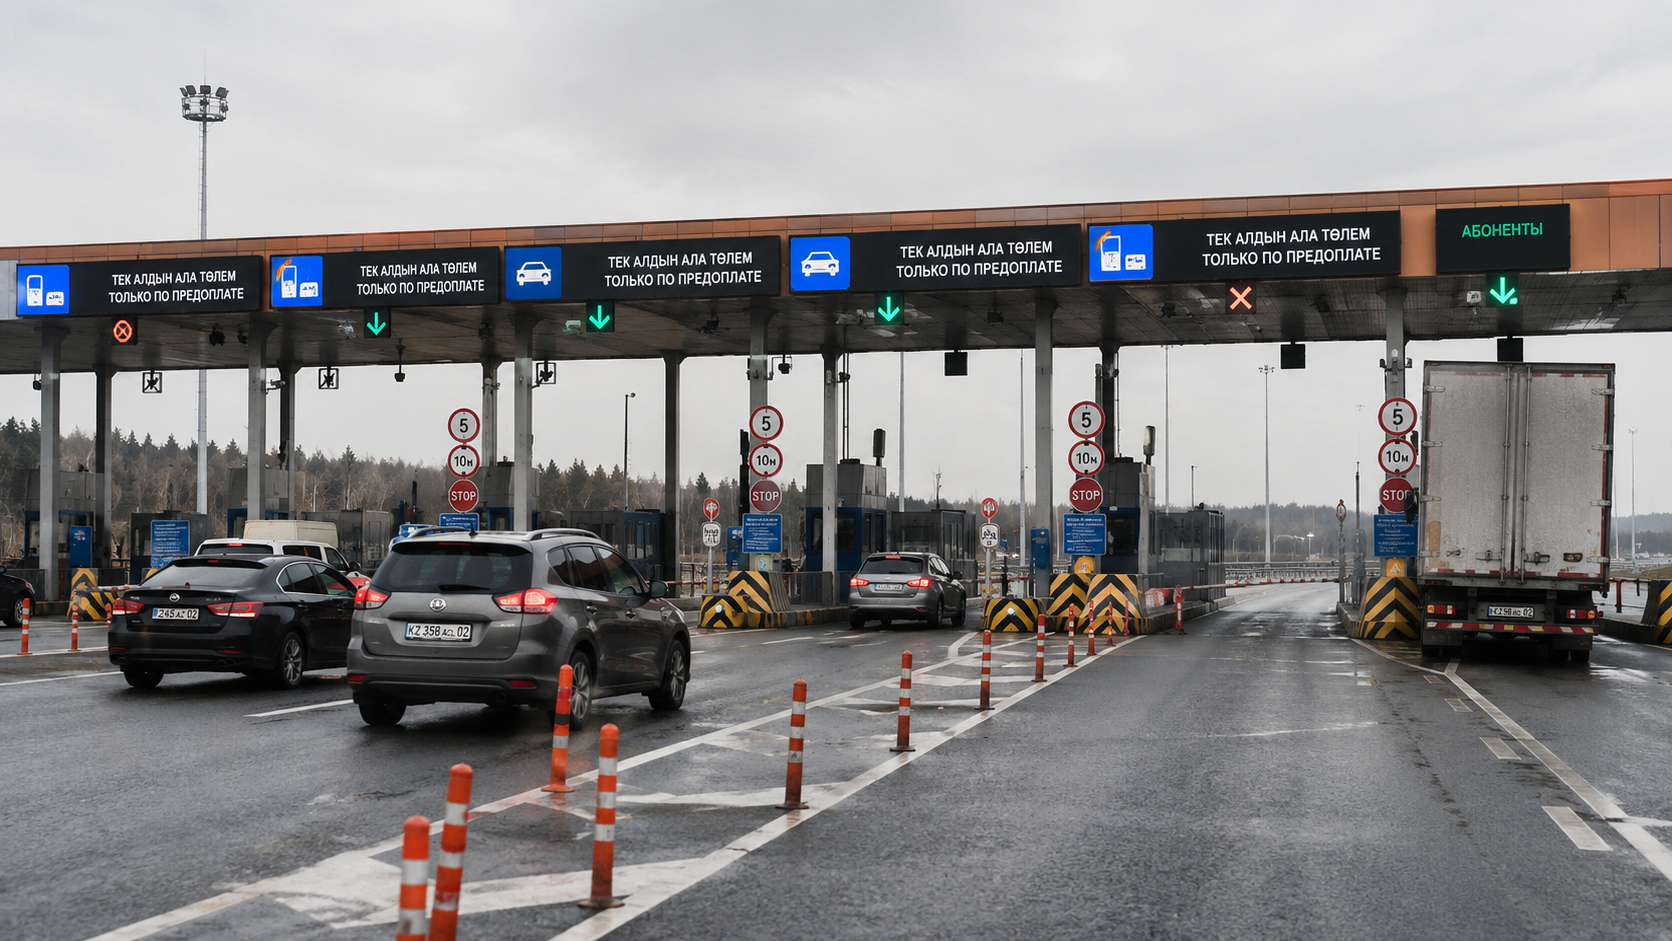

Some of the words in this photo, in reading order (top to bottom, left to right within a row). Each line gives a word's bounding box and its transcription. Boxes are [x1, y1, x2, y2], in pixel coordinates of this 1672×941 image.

[1206, 233, 1232, 246] ТЕК
[1234, 231, 1286, 247] АЛДЫН
[1289, 230, 1318, 243] АЛА
[1321, 227, 1371, 242] ТӨЛЕМ
[1461, 222, 1543, 238] АБОНЕНТЫ
[900, 245, 923, 259] ТЕК
[926, 244, 974, 259] АЛДЫН
[977, 242, 1004, 256] АЛА
[1006, 241, 1052, 255] ТӨЛЕМ
[1201, 252, 1258, 267] ТОЛЬКО
[1262, 251, 1283, 264] ПО
[1286, 247, 1382, 264] ПРЕДОПЛАТЕ
[608, 256, 630, 268] ТЕК
[633, 254, 678, 269] АЛДЫН
[681, 253, 706, 266] АЛА
[709, 252, 753, 265] ТӨЛЕМ
[895, 264, 948, 278] ТОЛЬКО
[951, 263, 970, 276] ПО
[974, 259, 1062, 277] ПРЕДОПЛАТЕ
[112, 274, 131, 286] ТЕК
[133, 272, 172, 286] АЛДЫН
[174, 271, 197, 284] АЛА
[199, 270, 236, 283] ТӨЛЕМ
[360, 265, 378, 277] ТЕК
[380, 264, 417, 278] АЛДЫН
[419, 263, 440, 275] АЛА
[441, 262, 477, 275] ТӨЛЕМ
[604, 274, 653, 288] ТОЛЬКО
[657, 273, 674, 286] ПО
[678, 270, 762, 286] ПРЕДОПЛАТЕ
[108, 290, 151, 303] ТОЛЬКО
[154, 290, 170, 302] ПО
[172, 288, 244, 302] ПРЕДОПЛАТЕ
[356, 282, 397, 295] ТОЛЬКО
[399, 281, 414, 294] ПО
[416, 280, 485, 295] ПРЕДОПЛАТЕ
[761, 415, 771, 431] 5
[1081, 411, 1092, 428] 5
[1392, 408, 1403, 426] 5
[459, 418, 469, 433] 5
[1076, 452, 1097, 464] 10м
[1386, 450, 1409, 463] 10м
[451, 491, 476, 502] STOP
[752, 491, 779, 502] STOP
[1072, 490, 1100, 501] STOP
[187, 609, 198, 619] 02
[409, 625, 421, 636] KZ
[457, 626, 469, 638] 02
